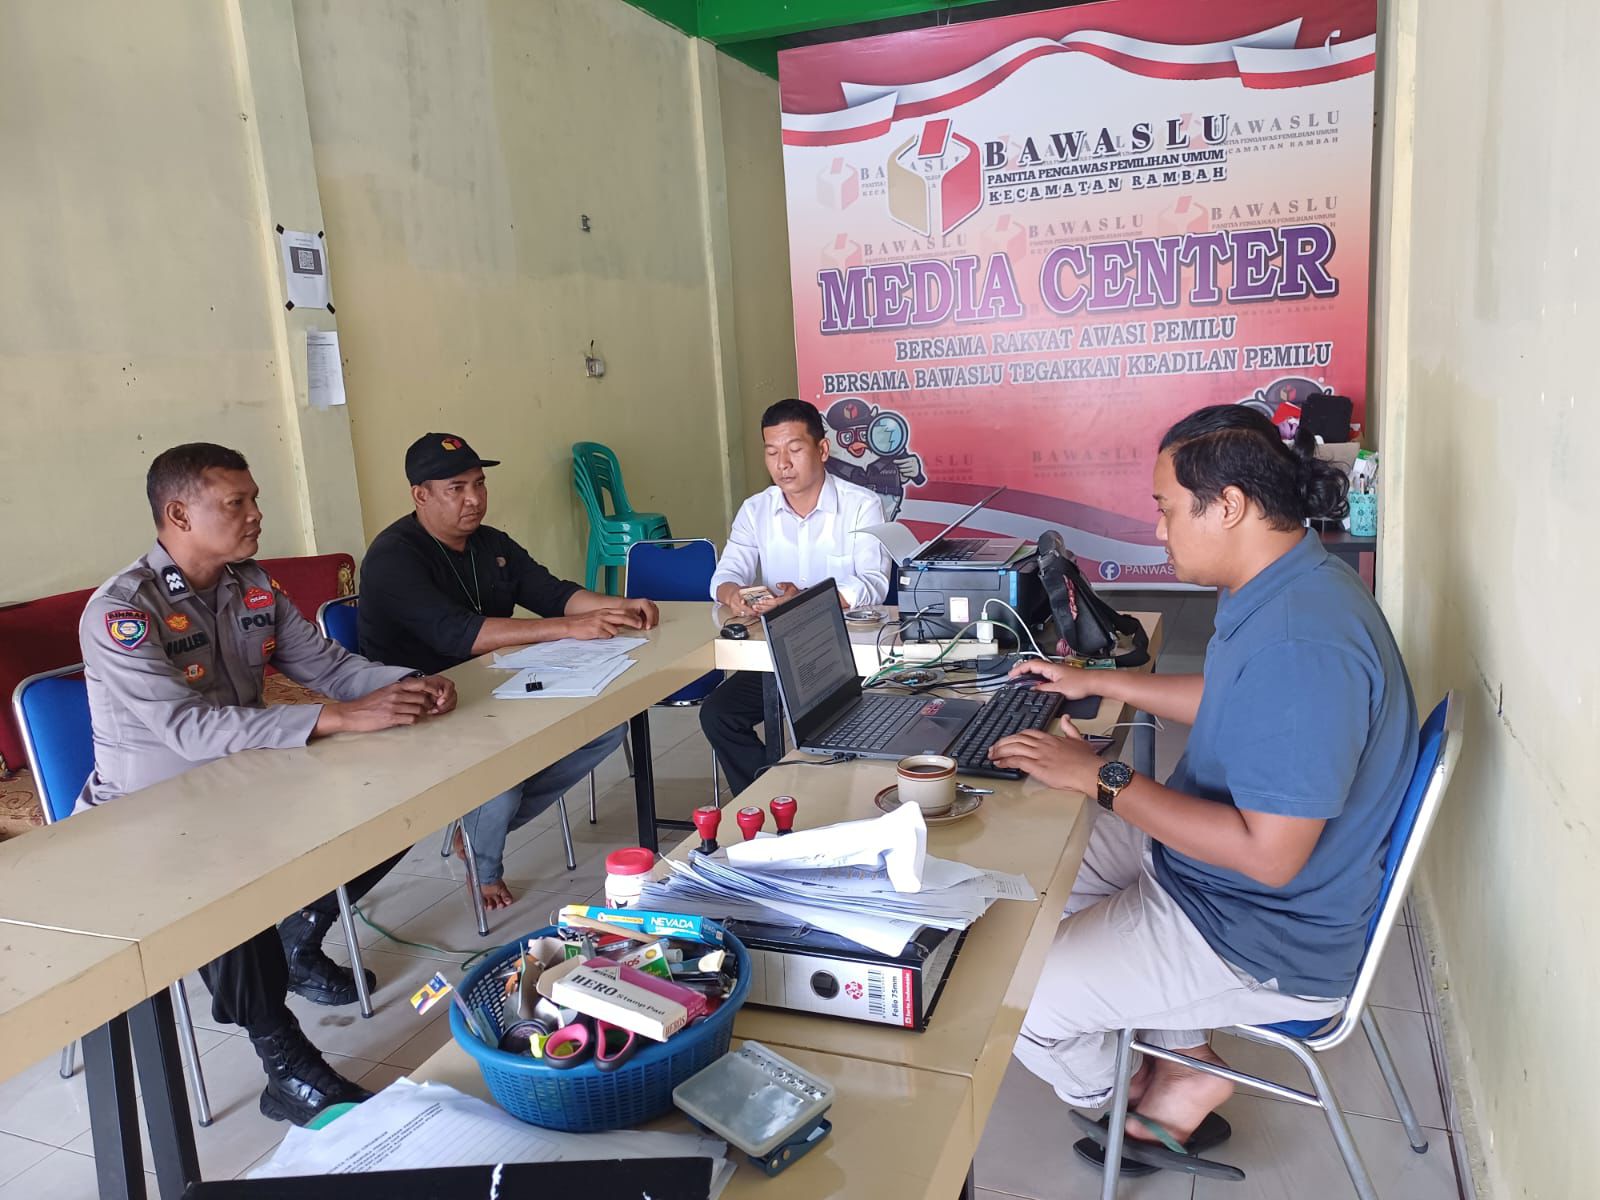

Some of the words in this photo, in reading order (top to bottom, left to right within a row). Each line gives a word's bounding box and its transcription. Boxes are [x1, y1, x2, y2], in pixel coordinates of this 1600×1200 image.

[984, 114, 1227, 168] BAWASLU
[988, 170, 1036, 185] PANITIA
[1038, 162, 1108, 179] PENGAWAS
[1110, 153, 1179, 171] PEMILIHAN
[1182, 149, 1224, 162] UMUM
[989, 178, 1120, 202] KECAMATAN
[1132, 166, 1224, 186] RAMBAH
[1029, 214, 1144, 239] BAWASLU
[1210, 195, 1338, 221] BAWASLU
[818, 253, 1023, 333] MEDIA
[1040, 224, 1337, 315] CENTER
[896, 335, 987, 361] BERSAMA
[992, 329, 1073, 354] RAKYAT
[1079, 324, 1146, 348] AWASI
[1153, 317, 1236, 343] PEMILU
[824, 370, 910, 394] BERSAMA
[915, 365, 1003, 389] BAWASLU
[1009, 357, 1120, 383] TEGAKKAN
[1127, 349, 1237, 376] KEADILAN
[1245, 343, 1331, 369] PEMILU
[651, 917, 694, 930] NEVADA
[571, 975, 618, 997] HERO
[617, 993, 647, 1011] Stamp
[646, 1004, 666, 1016] Pad
